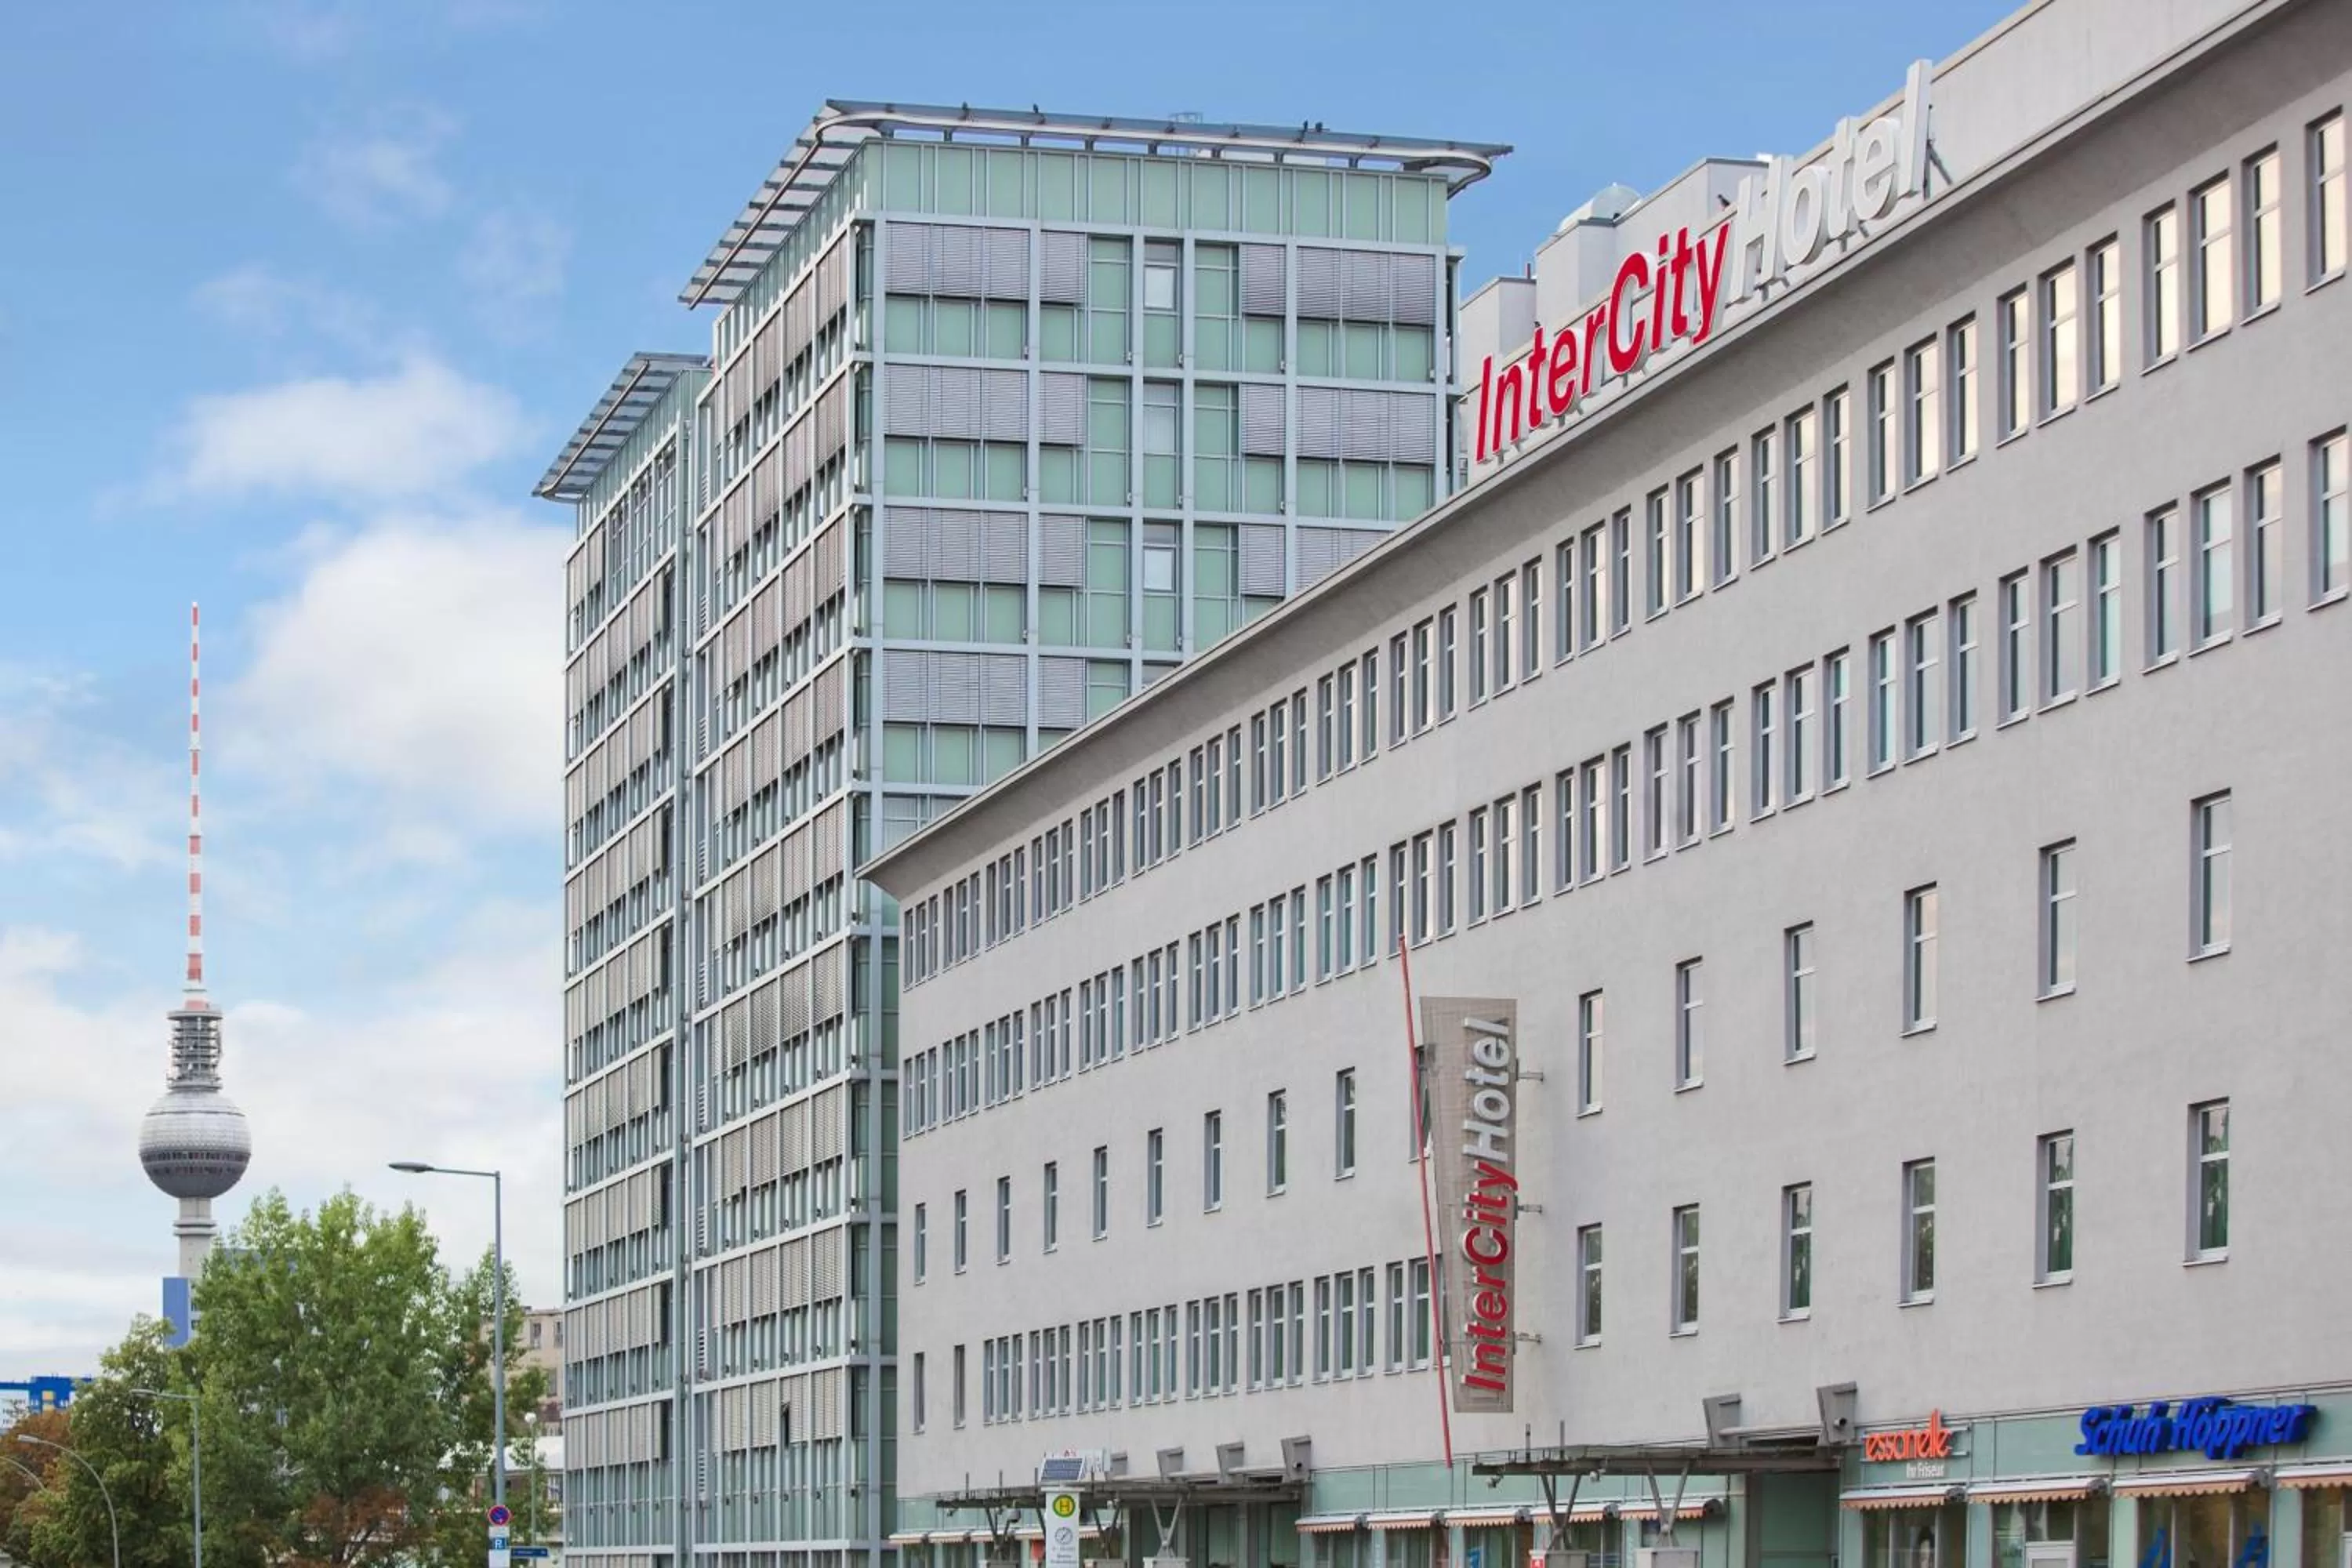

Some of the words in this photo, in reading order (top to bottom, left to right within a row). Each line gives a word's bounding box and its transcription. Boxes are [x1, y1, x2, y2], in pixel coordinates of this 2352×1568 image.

[1476, 59, 1932, 463] InterCityHotel
[1461, 1017, 1518, 1391] InterCityHotel
[1865, 1408, 1951, 1461] essanelle
[2074, 1402, 2171, 1456] Schuh
[1059, 1499, 1070, 1512] H
